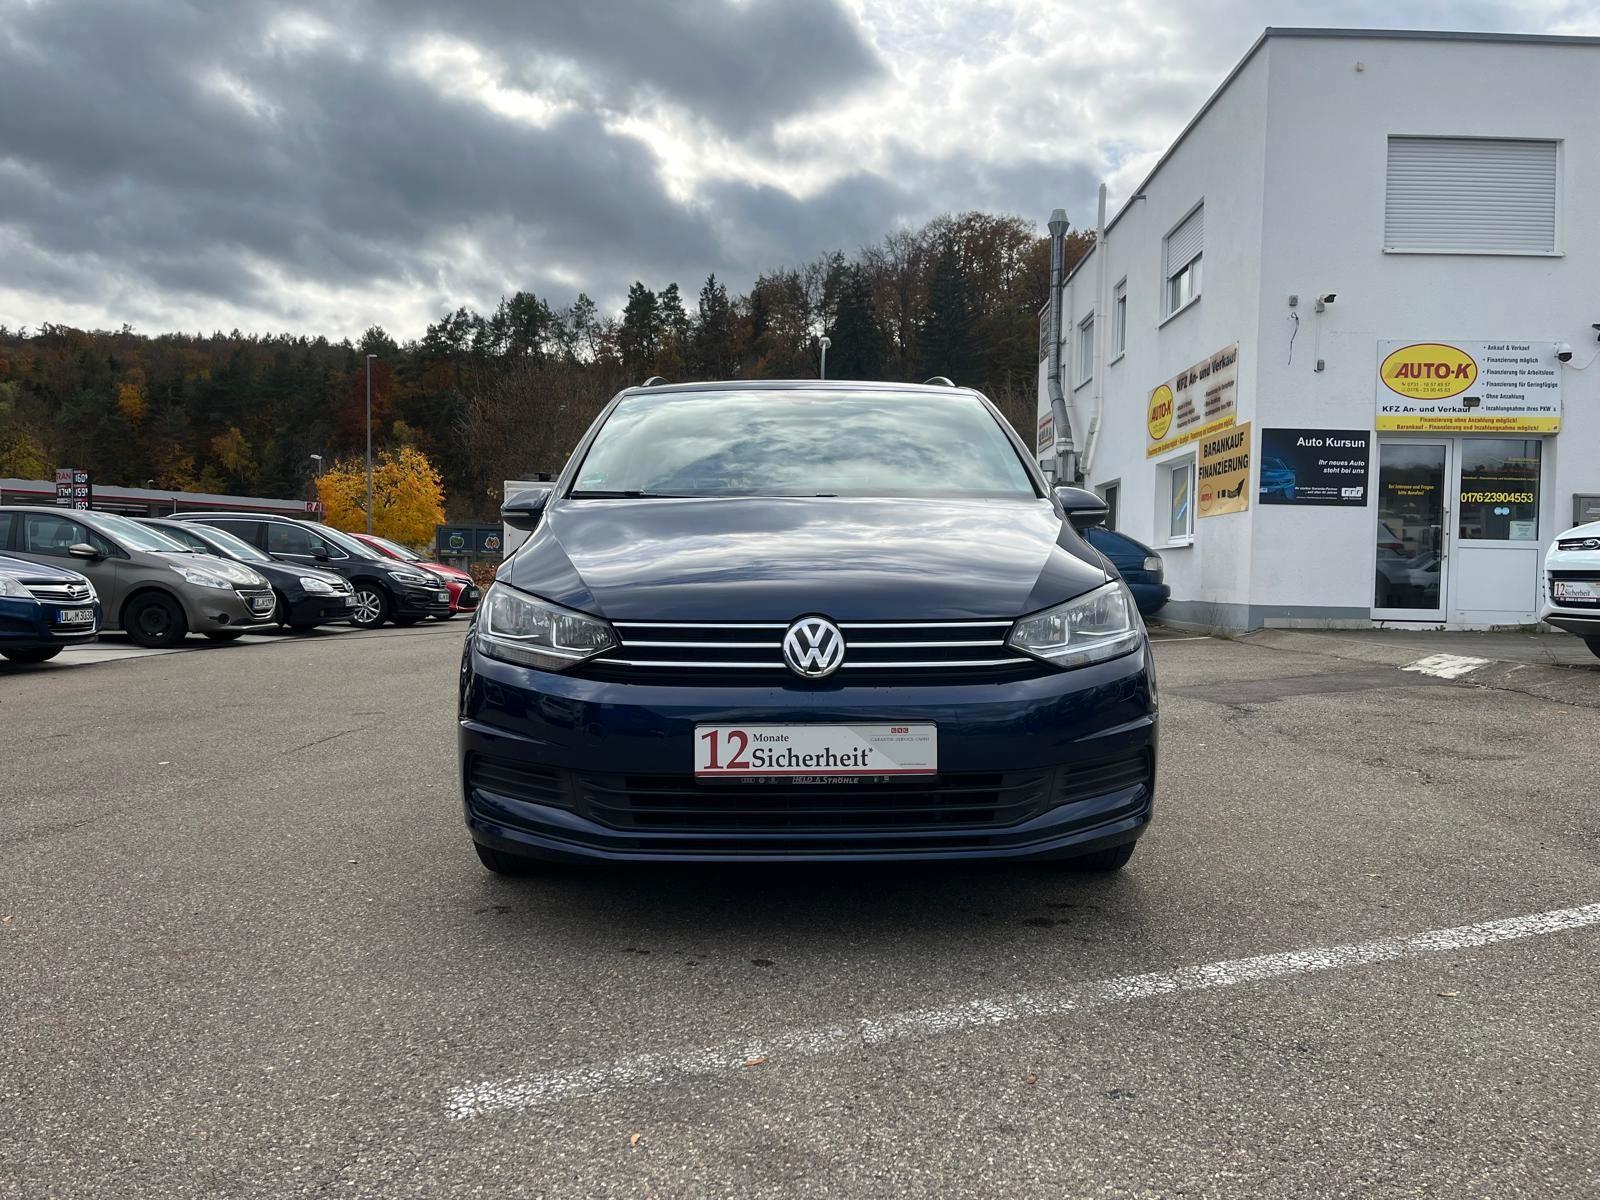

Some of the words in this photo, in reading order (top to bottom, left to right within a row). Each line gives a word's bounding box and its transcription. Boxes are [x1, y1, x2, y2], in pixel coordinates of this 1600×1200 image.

[1176, 375, 1188, 392] KFZ
[1189, 372, 1198, 386] An-
[1199, 362, 1210, 380] und
[1212, 348, 1237, 374] Verkauf
[1394, 362, 1472, 379] AUTO-K
[1152, 399, 1172, 421] AUTO-K
[1204, 432, 1244, 458] BARANKAUF
[1296, 437, 1322, 447] Auto
[1326, 438, 1365, 448] Kursun
[1556, 583, 1565, 595] 12
[62, 611, 71, 621] UL
[701, 729, 750, 770] 12
[752, 733, 789, 742] Monate
